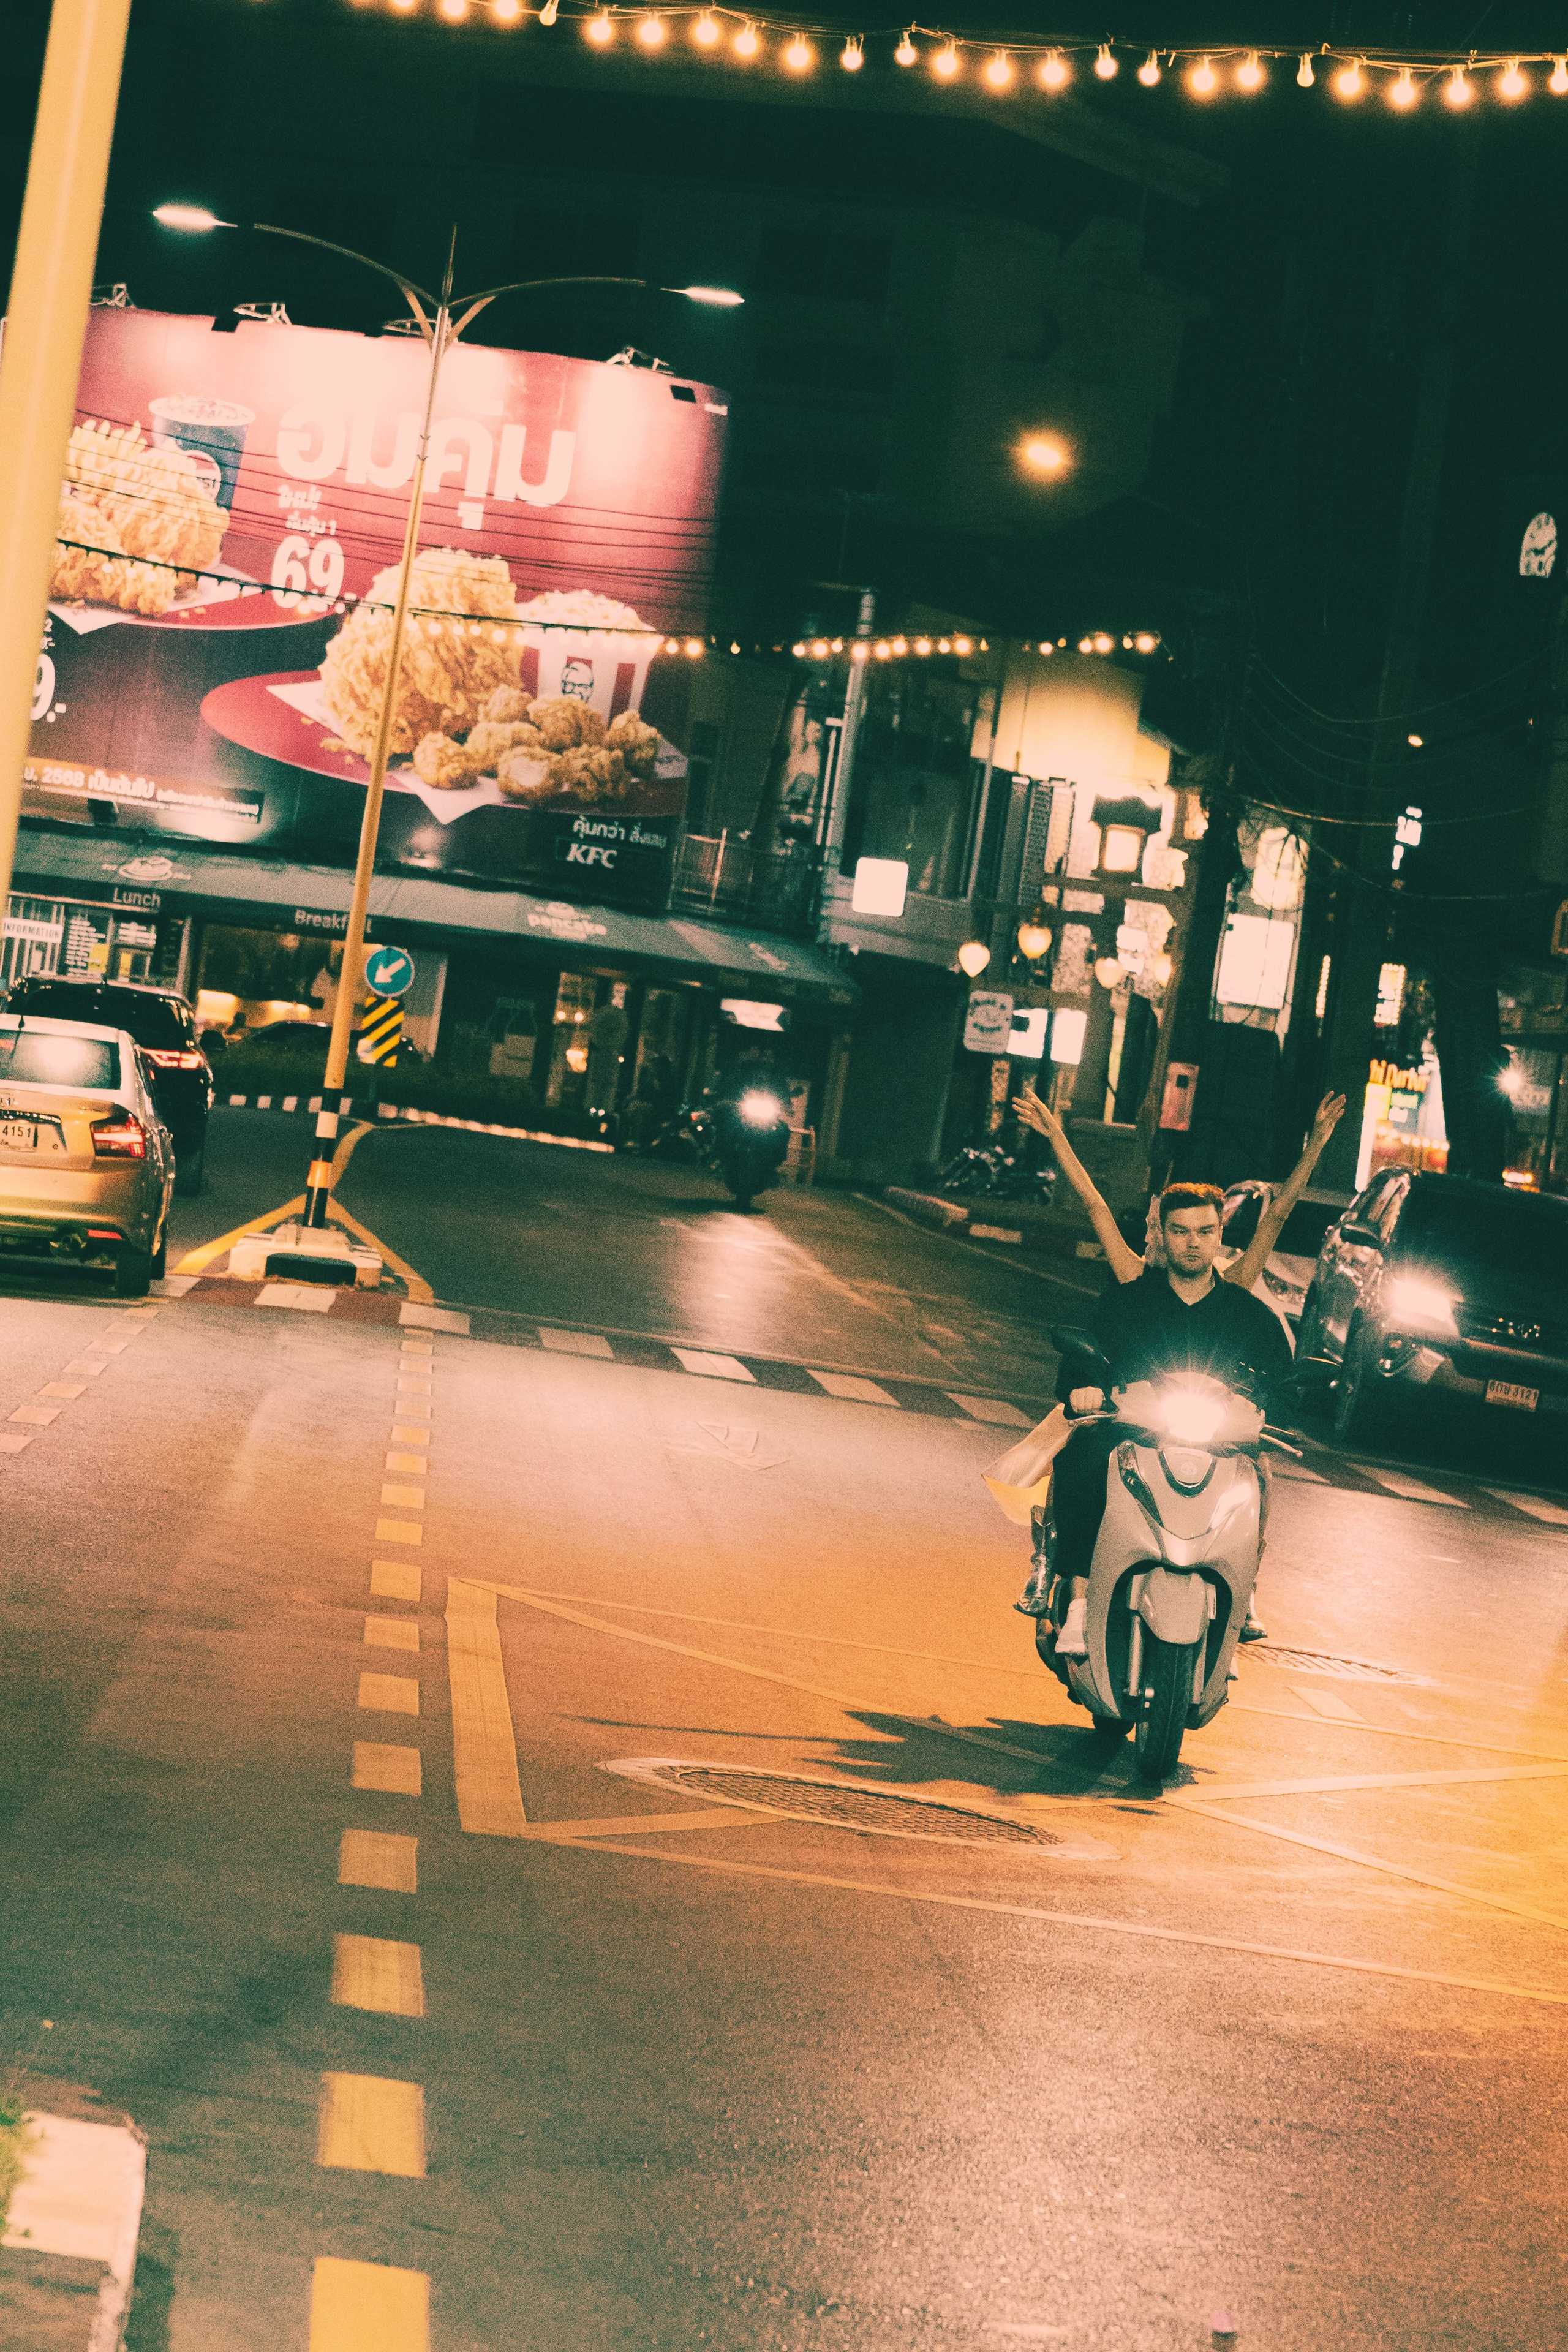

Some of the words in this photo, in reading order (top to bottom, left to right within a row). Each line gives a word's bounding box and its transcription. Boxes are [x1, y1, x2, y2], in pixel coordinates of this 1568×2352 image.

[41, 767, 85, 788] 2568
[566, 843, 617, 869] KFC
[113, 887, 161, 908] Lunch
[3, 922, 61, 938] INFORMATION
[295, 909, 372, 933] Breakft
[2, 1125, 31, 1138] 4151
